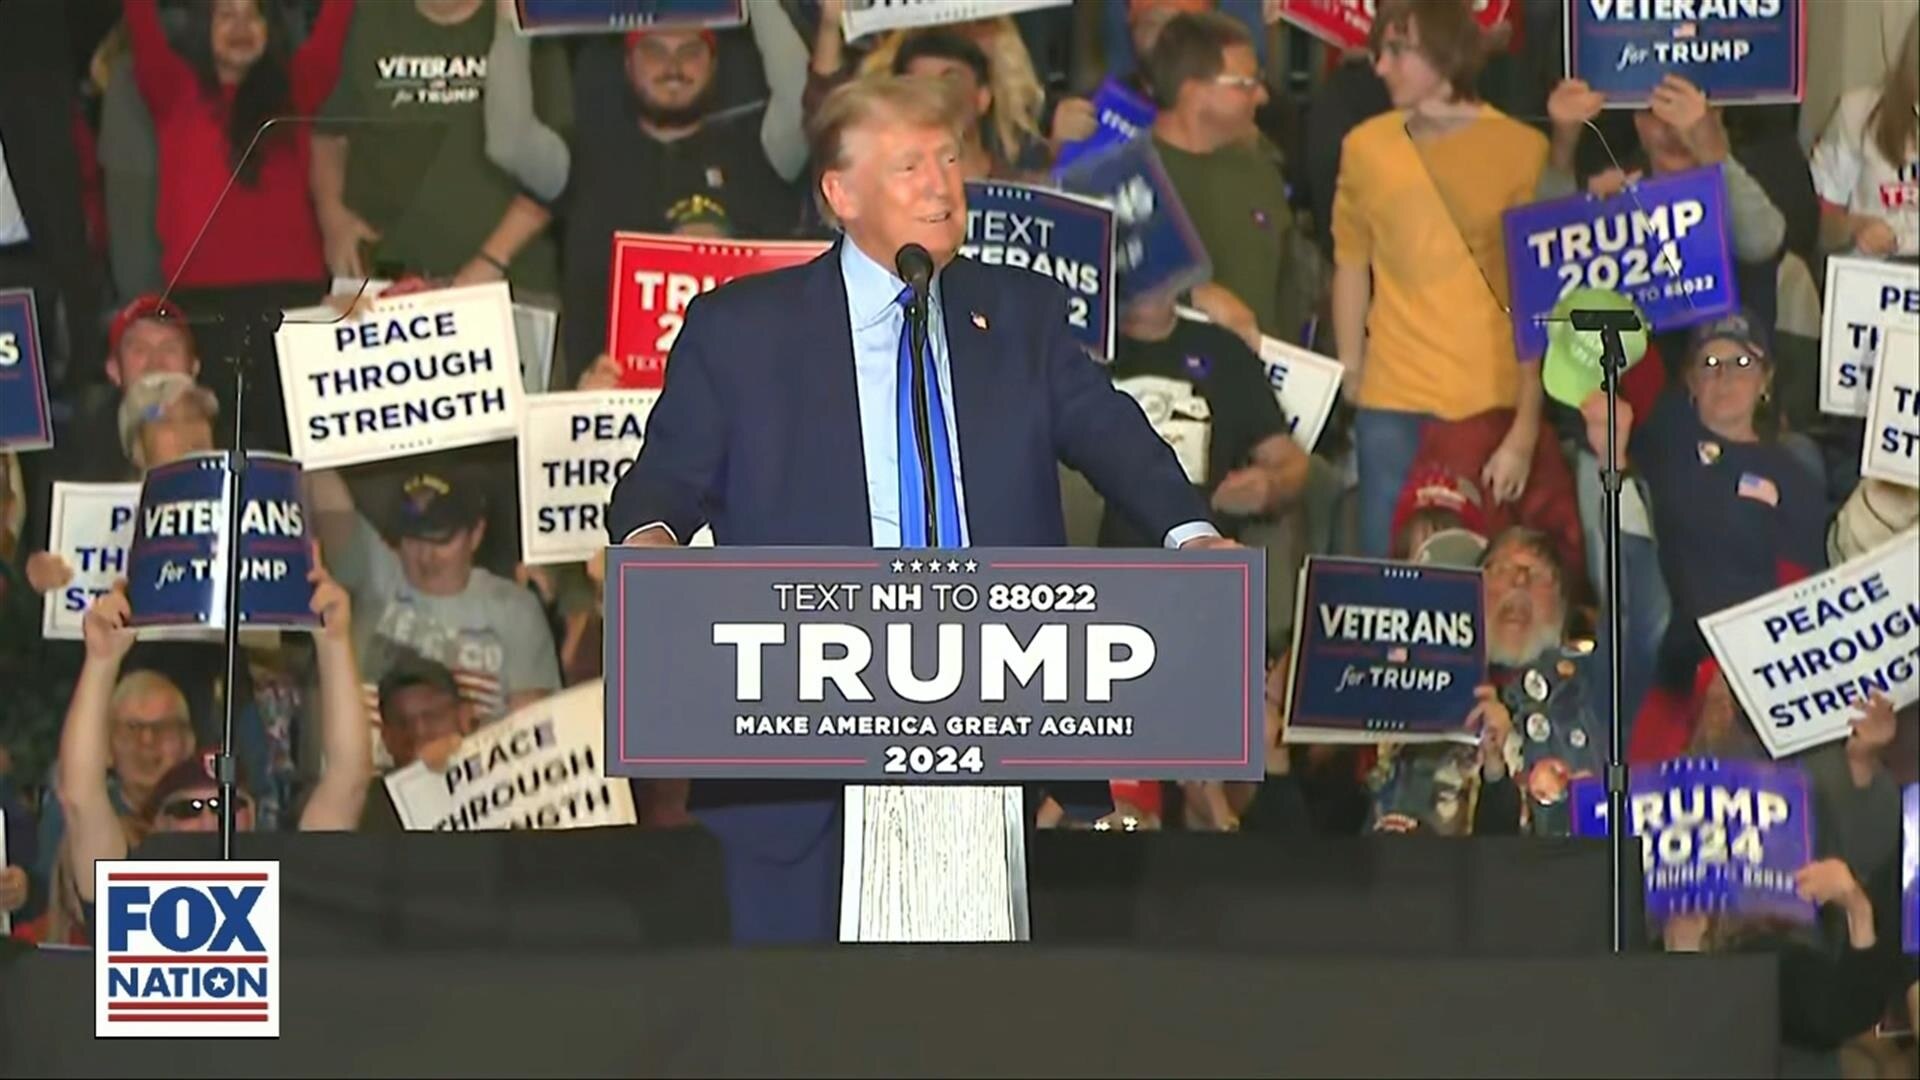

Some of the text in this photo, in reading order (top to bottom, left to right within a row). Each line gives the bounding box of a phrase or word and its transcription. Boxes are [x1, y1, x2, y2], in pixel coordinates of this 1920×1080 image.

[374, 55, 488, 79] VETERAN
[1616, 40, 1749, 71] for TRUMP
[1528, 200, 1704, 268] TRUMP
[1557, 240, 1684, 299] 2024
[335, 312, 457, 352] PEACE
[308, 348, 493, 397] THROUGH
[309, 387, 505, 441] STRENGTH
[154, 560, 185, 590] for
[190, 557, 288, 582] TMP
[773, 584, 1096, 611] TEXT NH TO 88022
[1764, 572, 1890, 644] PEACE
[1319, 603, 1474, 647] VETERANS
[712, 623, 1157, 702] TRUMP
[1335, 664, 1452, 693] for TRUMP
[736, 716, 1134, 735] MAKE AMERICA GREAT AGAIN!
[445, 718, 556, 796] PEACE
[884, 746, 984, 773] 2024
